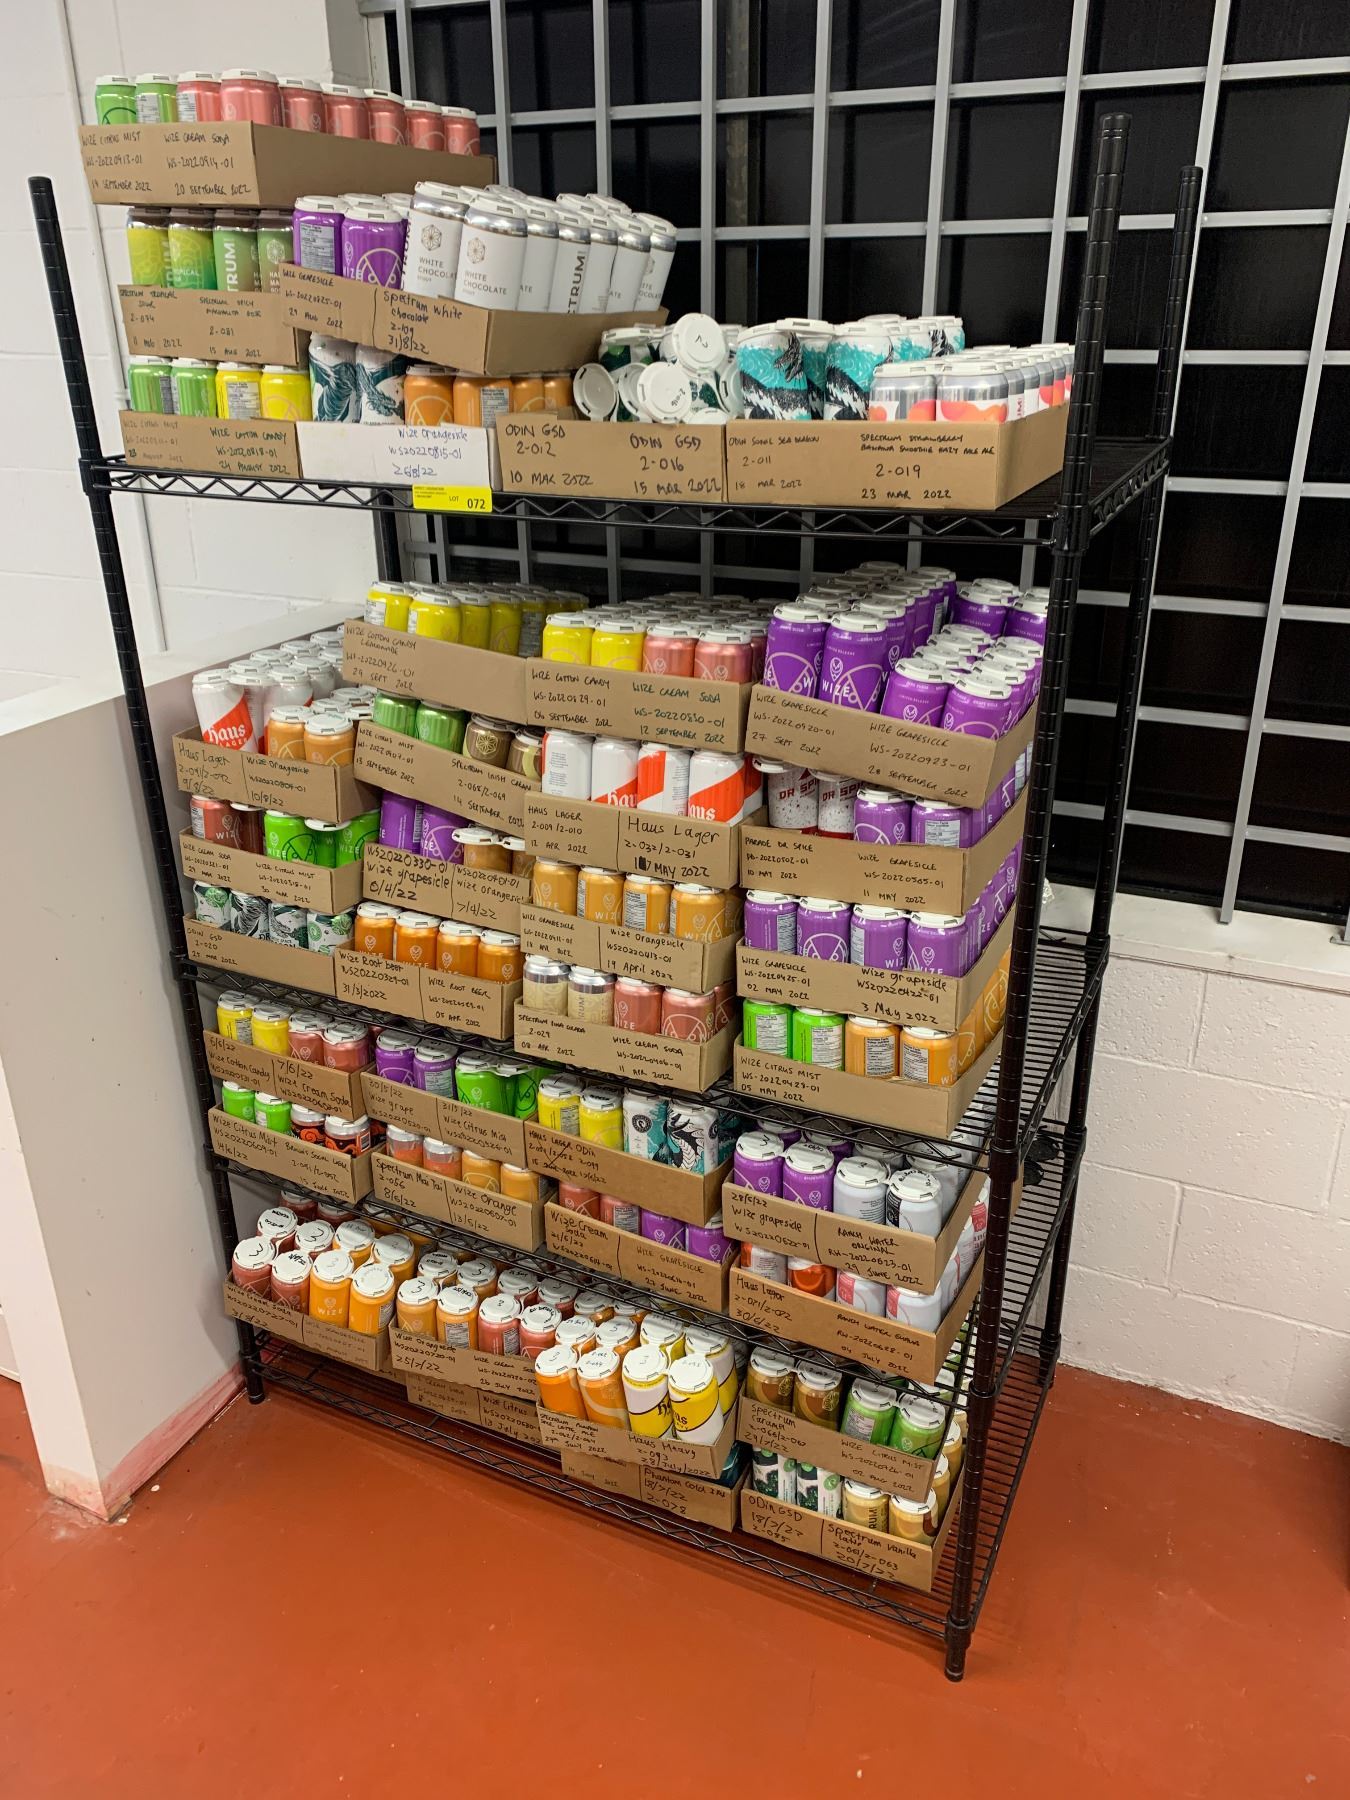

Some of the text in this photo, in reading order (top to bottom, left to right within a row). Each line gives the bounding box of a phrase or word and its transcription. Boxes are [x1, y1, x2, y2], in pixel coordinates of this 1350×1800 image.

[123, 131, 141, 142] MIST
[165, 132, 230, 146] WIZE CREAM SODA
[103, 179, 152, 192] SEPTEMBER 2022
[190, 184, 226, 196] SEPTEMBER
[420, 258, 444, 271] WHITE
[465, 272, 487, 285] WHITE
[464, 280, 508, 297] CHOCOLATE
[384, 291, 428, 313] Spectrum
[327, 317, 343, 329] 2022
[210, 428, 231, 438] WIZE
[505, 423, 566, 439] ODIN GSD
[861, 434, 902, 445] SPECTRUM
[517, 441, 557, 457] 2-012
[630, 433, 701, 451] ODIN GSD
[899, 446, 959, 455] SMOOTHIE HAZY
[269, 463, 290, 475] 2022
[640, 457, 684, 472] 2-016
[743, 456, 772, 467] 2-011
[510, 471, 594, 487] 10 MAR 2022
[875, 463, 921, 480] 2-019
[635, 478, 722, 496] 15 MAR 2022
[758, 480, 803, 490] MAR 2022
[861, 488, 952, 500] 23 MAR 2022
[467, 499, 486, 510] 072
[346, 627, 365, 636] WIZE
[370, 672, 414, 692] SEPT 2022
[531, 668, 610, 689] WIZE CANDY
[632, 681, 721, 704] WIZE CREAM SODA
[822, 678, 851, 702] WIZE
[756, 692, 829, 721] WIZE GRAPESICLE
[550, 713, 613, 727] SEPTEMBER 2022
[753, 709, 835, 738] WS-20220920-01
[211, 724, 246, 746] haus
[640, 724, 725, 745] 12 SEPTEMBER 2022
[752, 731, 822, 756] 27 SEPT 2022
[869, 722, 950, 747] WIZE GRAPESICLE
[180, 742, 231, 770] Haus Lager
[869, 745, 971, 774] WS-20220923-01
[366, 761, 398, 777] SEPTEMBER
[487, 771, 506, 783] IRISH
[888, 771, 968, 798] SEPTEMBER 2022
[251, 790, 284, 807] 10/8/22
[779, 788, 796, 803] DR
[822, 791, 837, 804] DR
[528, 805, 583, 824] HAUS LAGER
[627, 817, 720, 848] Haus Lager
[531, 840, 588, 855] 12 APR 2022
[793, 842, 814, 853] SPICE
[654, 863, 710, 879] MAY 2022
[858, 853, 937, 871] WIZE GRAPESICLE
[398, 868, 450, 890] grapesicle
[780, 871, 798, 880] 2022
[878, 893, 926, 905] MAY 2022
[635, 933, 685, 951] Orangesicle
[606, 941, 672, 963] WS20220413-01
[362, 954, 404, 972] Root beer
[607, 960, 673, 980] 19 April 2022
[741, 955, 807, 973] WIZE GRAPESICLE
[861, 967, 885, 979] Wize
[342, 982, 387, 1003] 31/3/2022
[747, 983, 810, 1000] 02 MAY 2022
[517, 1014, 548, 1025] SPECTRUM
[863, 1002, 939, 1026] 3 May 2022
[537, 1043, 576, 1057] APR 2022
[612, 1036, 684, 1057] WIZE CREAM SODA
[278, 1059, 313, 1080] 7/6/22
[632, 1068, 674, 1081] APR 2022
[740, 1055, 822, 1080] WIZE CITRUS MIST
[330, 1091, 352, 1109] Soda
[741, 1084, 805, 1102] 05 MAY 2022
[388, 1100, 414, 1117] grape
[212, 1113, 258, 1140] Wize Citrus
[463, 1120, 488, 1139] Citrus
[375, 1157, 443, 1192] Spectrum Mai Tai
[453, 1182, 517, 1217] Wize Orange
[579, 1218, 610, 1241] Cream
[837, 1228, 900, 1249] RANCH WATER
[851, 1242, 896, 1257] ORIGINAL
[736, 1274, 759, 1292] Haus
[866, 1268, 924, 1287] JUNE 2022
[837, 1313, 892, 1338] RANCH WATER
[750, 1404, 797, 1430] Spectrum
[627, 1434, 697, 1460] Haus Heavy
[840, 1440, 925, 1470] WIZE MIST
[644, 1466, 682, 1489] Phantom
[891, 1482, 915, 1494] 2022
[749, 1496, 803, 1523] ODin GSD
[827, 1522, 917, 1560] Spectrum Vanilla
